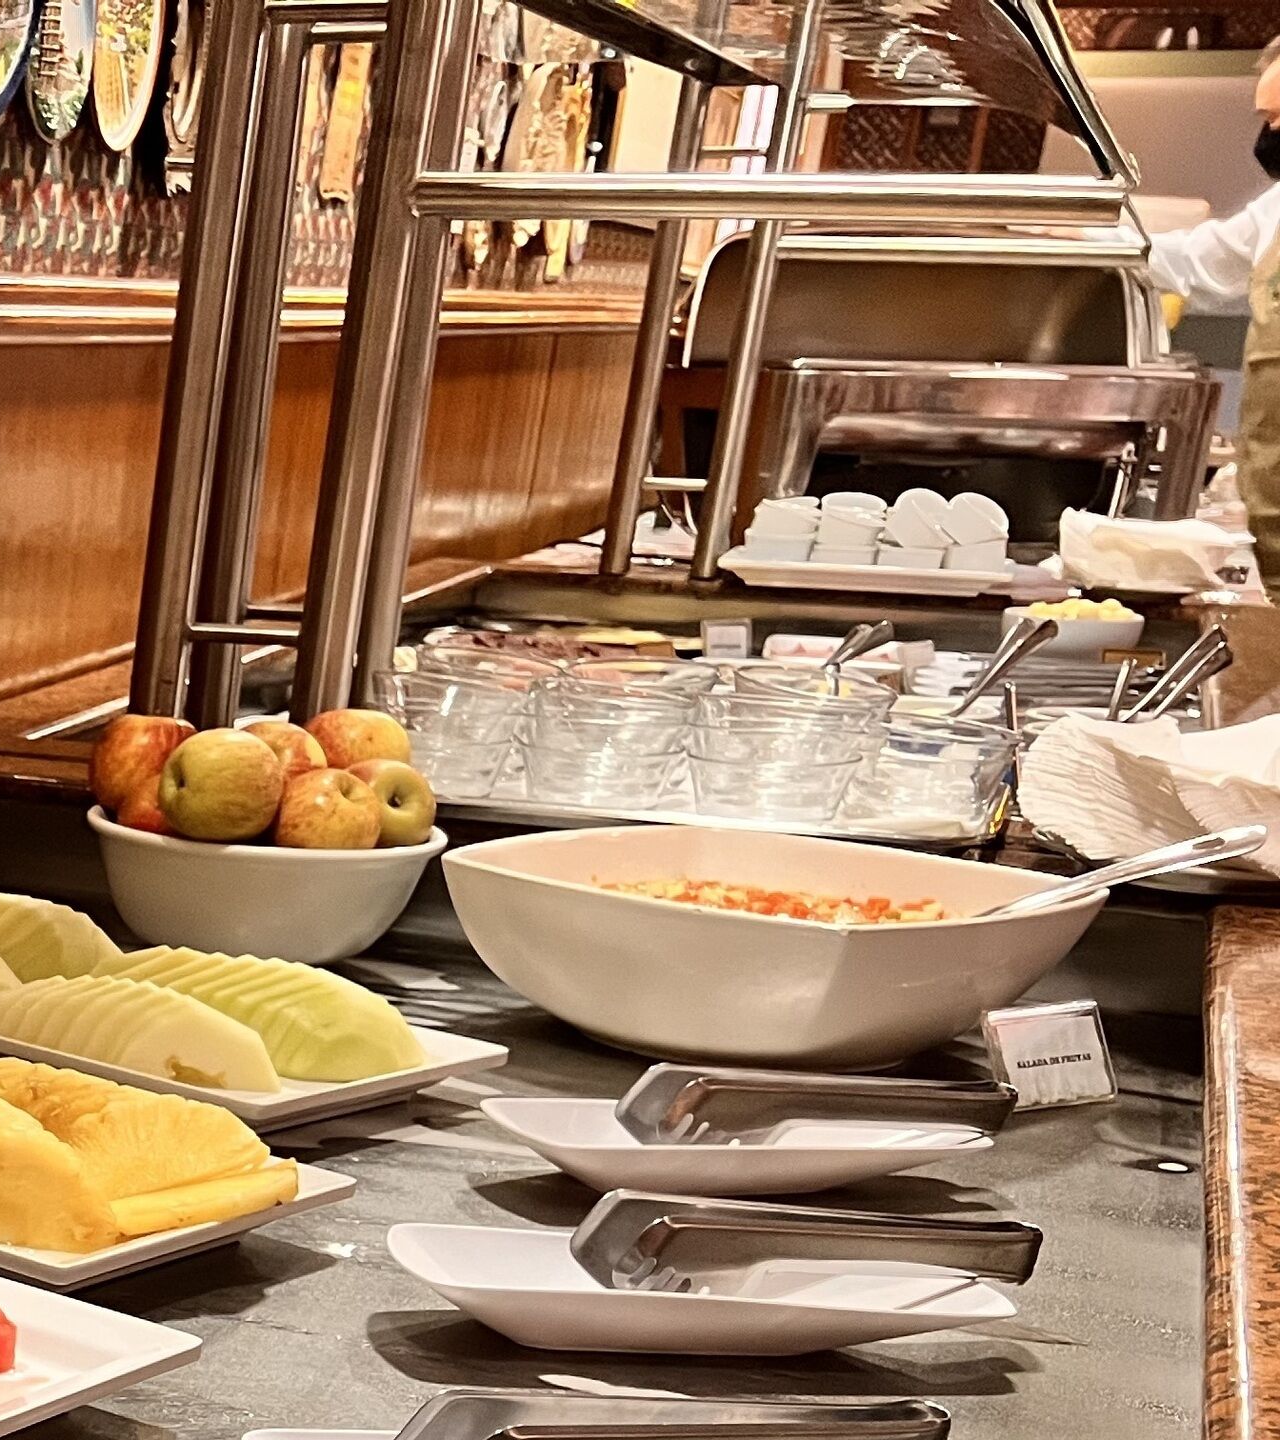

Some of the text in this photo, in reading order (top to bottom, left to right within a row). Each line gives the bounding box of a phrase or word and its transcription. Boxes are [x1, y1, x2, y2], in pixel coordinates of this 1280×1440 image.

[1017, 1053, 1092, 1069] SALADA DE FRUTAS
